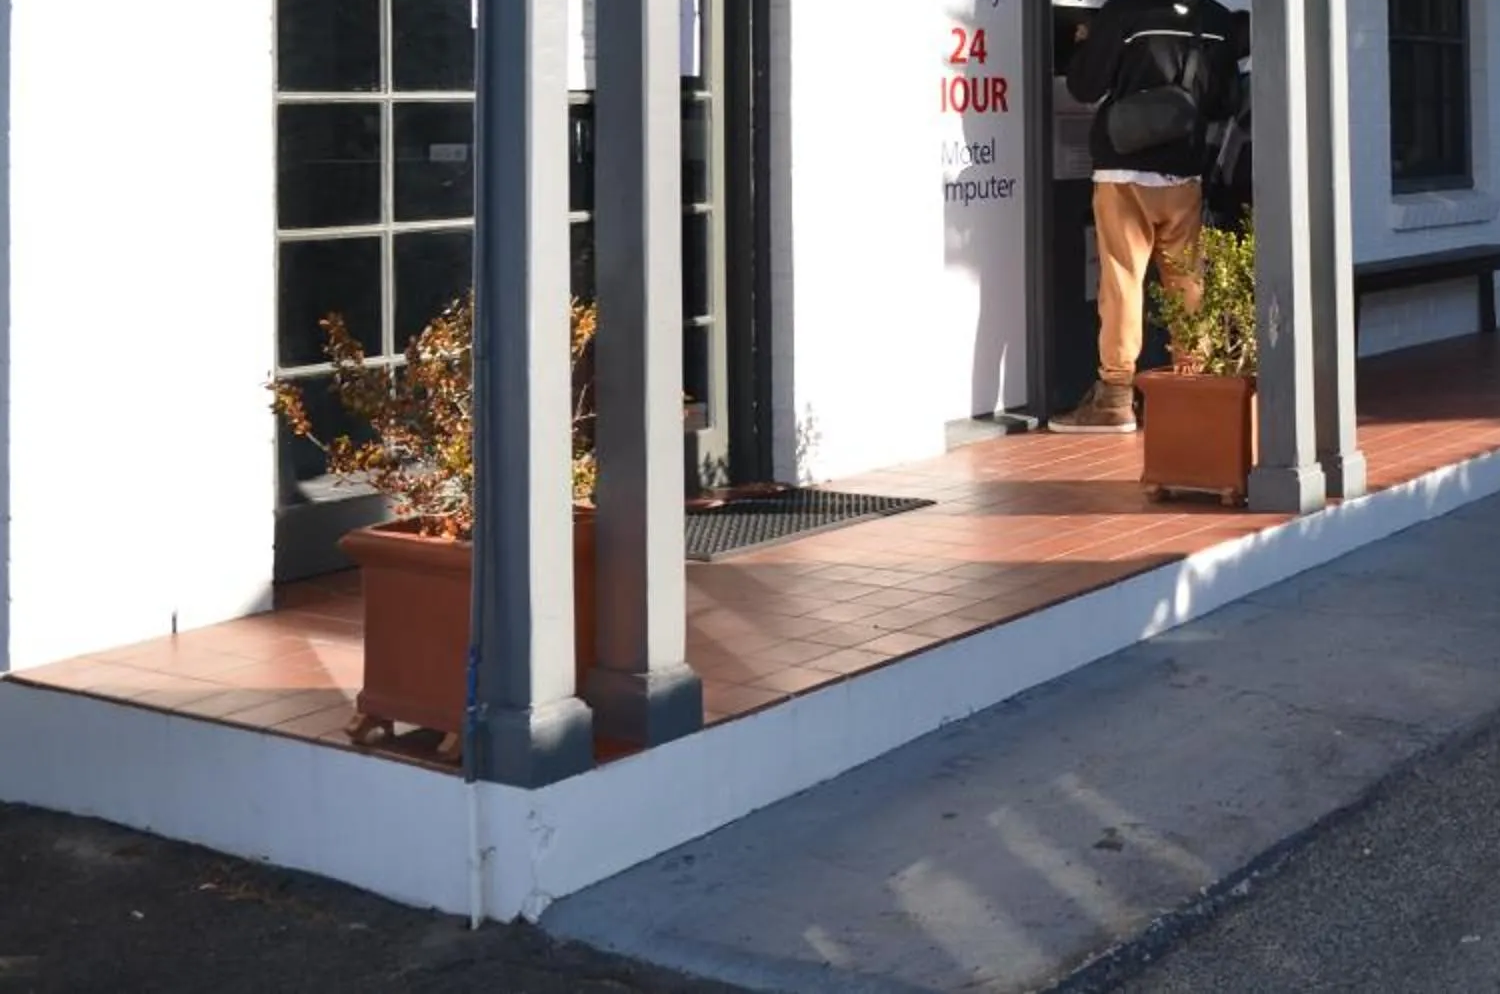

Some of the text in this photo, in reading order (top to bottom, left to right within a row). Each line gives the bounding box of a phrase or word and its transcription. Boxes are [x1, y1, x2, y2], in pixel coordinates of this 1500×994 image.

[950, 27, 988, 64] 24
[941, 136, 995, 165] Motel
[944, 175, 1017, 206] mputer
